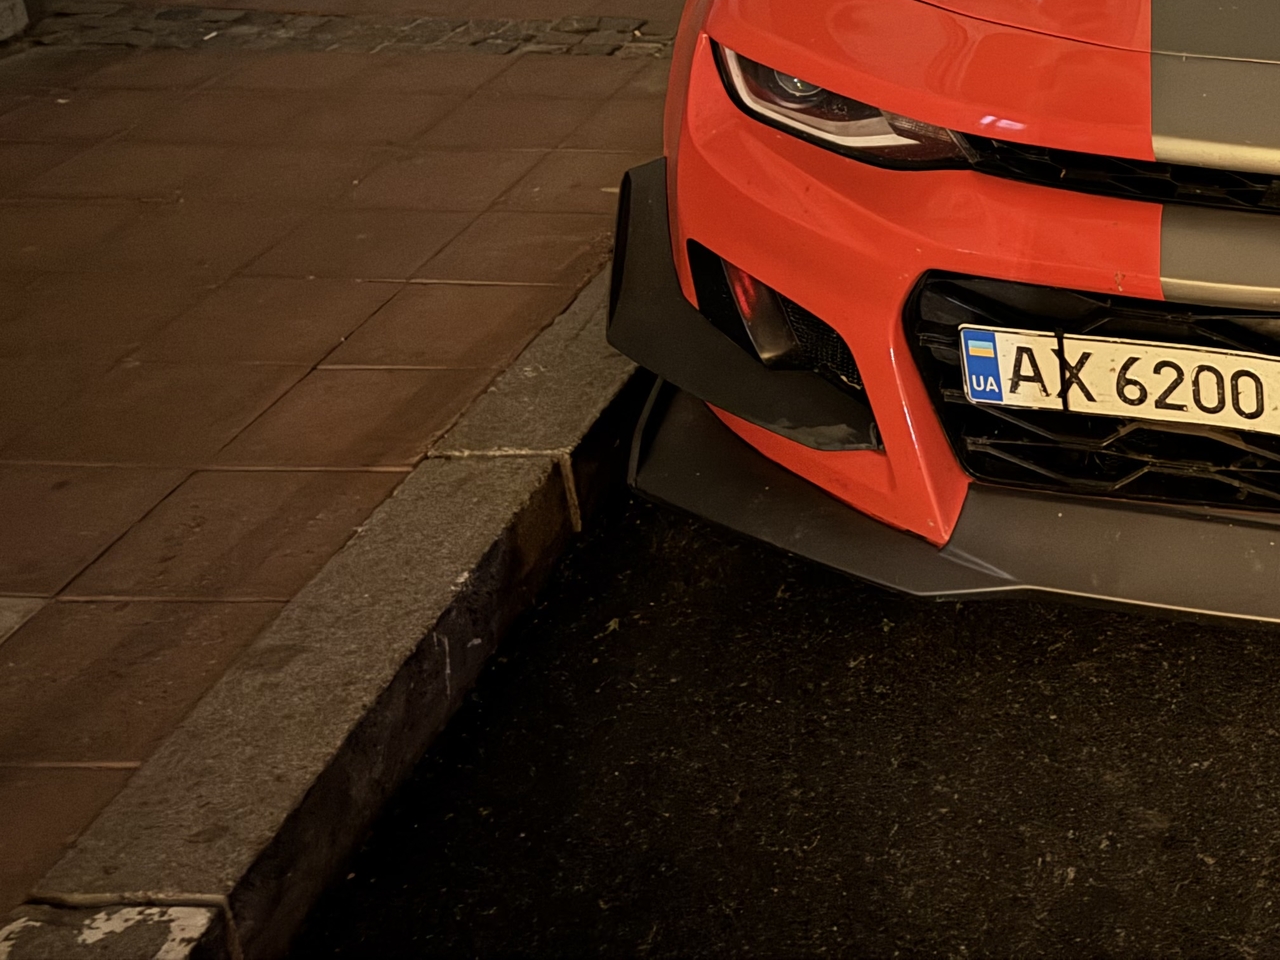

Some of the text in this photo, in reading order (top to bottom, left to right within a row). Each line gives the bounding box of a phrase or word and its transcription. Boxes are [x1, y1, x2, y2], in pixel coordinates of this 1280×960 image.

[971, 374, 999, 394] UA
[1008, 346, 1097, 403] AX
[1116, 356, 1265, 420] 6200
